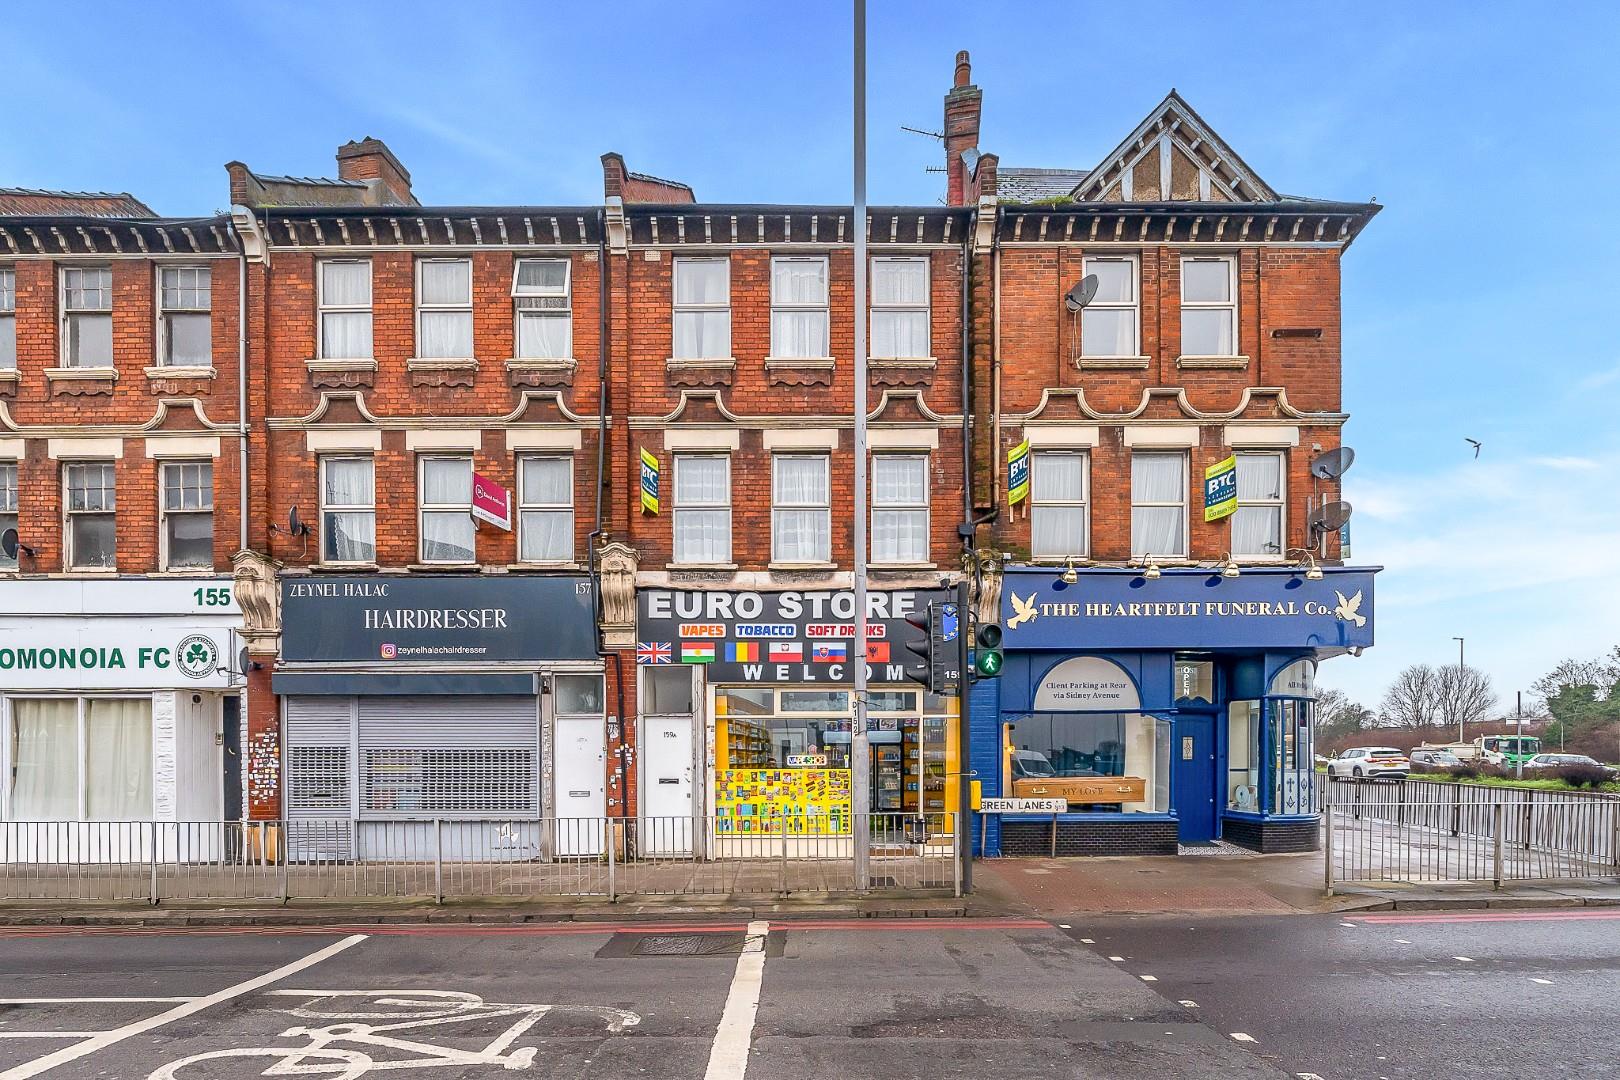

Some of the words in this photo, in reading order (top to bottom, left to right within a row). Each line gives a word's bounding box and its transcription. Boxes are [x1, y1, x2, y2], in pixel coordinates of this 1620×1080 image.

[1208, 470, 1234, 495] BTC
[289, 583, 340, 597] ZEYNEL
[344, 583, 390, 597] HALAC
[575, 582, 592, 595] 157
[193, 587, 231, 606] 155
[648, 591, 764, 619] EURO
[778, 591, 916, 619] STORE
[1040, 603, 1080, 617] THE
[1085, 602, 1201, 617] HEARTFELT
[1205, 601, 1300, 616] FUNERAL
[1304, 601, 1332, 615] Co.
[364, 608, 508, 629] HAIRDRESSER
[681, 624, 724, 637] VAPES
[737, 624, 795, 637] TOBACCO
[808, 625, 836, 636] SOFT
[840, 625, 884, 637] DRKS
[0, 647, 125, 669] OMONOIA
[139, 647, 171, 669] FC
[743, 664, 925, 681] WELCM
[1070, 682, 1098, 690] Parking
[1066, 692, 1091, 700] Sidney
[1062, 788, 1076, 796] MY
[1080, 787, 1104, 796] LOVE
[981, 801, 1014, 810] GREEN
[1018, 801, 1052, 810] LANES
